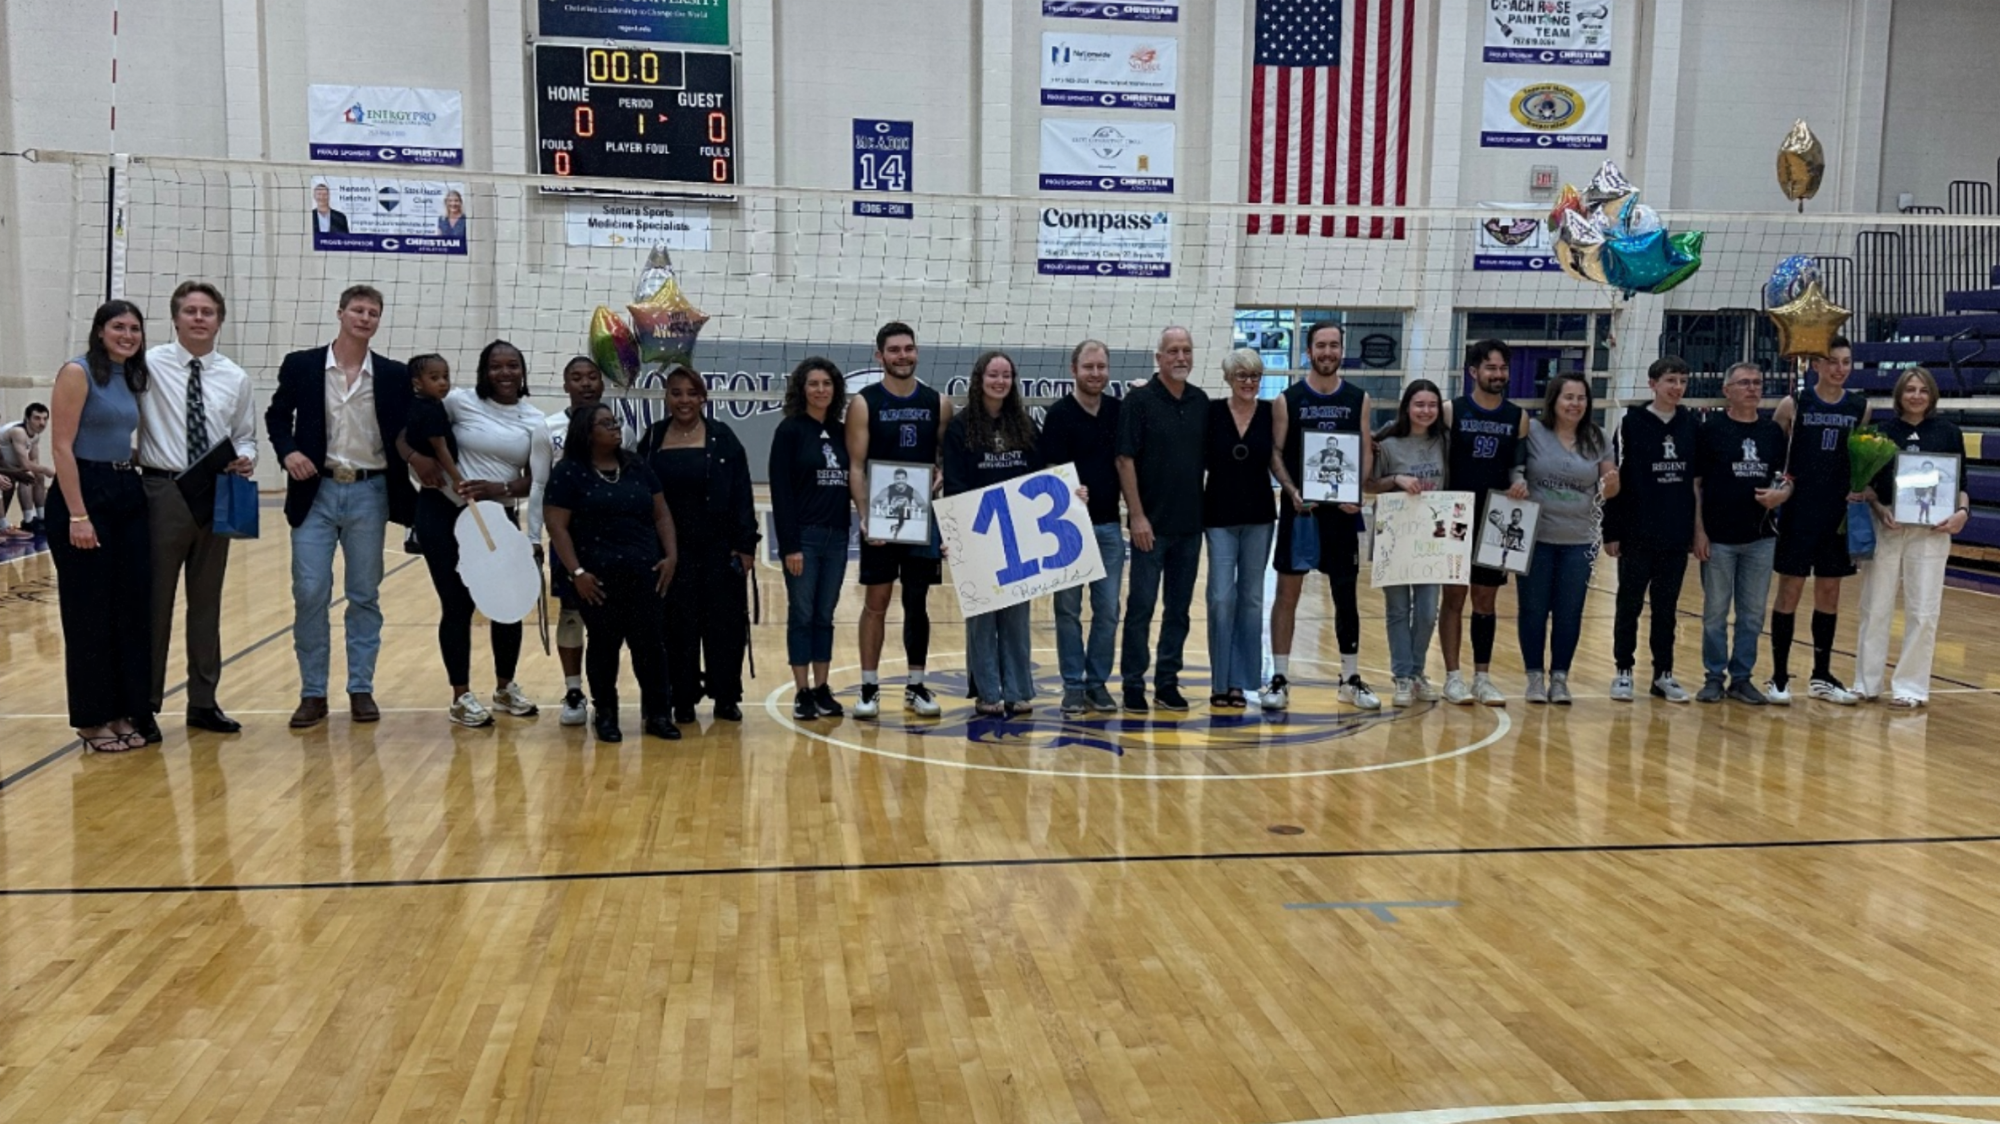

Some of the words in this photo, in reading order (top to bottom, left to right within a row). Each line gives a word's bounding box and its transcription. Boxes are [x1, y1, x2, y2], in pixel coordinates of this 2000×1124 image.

[1123, 6, 1173, 15] CHRISTIAN
[1536, 27, 1570, 37] TEAM
[1559, 51, 1605, 59] CHRISTIAN
[548, 86, 590, 102] HOME
[677, 92, 724, 108] GUEST
[1121, 94, 1170, 103] CHRISTIAN
[619, 97, 653, 110] PERIOD
[575, 106, 594, 137] 0
[708, 112, 726, 143] 0
[542, 139, 574, 150] FOULS
[1556, 135, 1602, 143] CHRISTIAN
[402, 148, 457, 158] CHRISTIAN
[605, 142, 643, 153] PLAYER
[645, 143, 670, 154] FOUL
[700, 147, 730, 157] FOULS
[555, 151, 571, 176] 0
[713, 158, 727, 181] 0
[860, 153, 906, 191] 14
[1120, 178, 1168, 187] CHRISTIAN
[602, 205, 641, 217] Sentara
[642, 206, 675, 220] Sports
[588, 217, 636, 230] Medicine
[637, 220, 691, 232] Specialists
[1043, 207, 1152, 234] Compass
[405, 238, 460, 248] CHRISTIAN
[1117, 262, 1165, 271] CHRISTIAN
[879, 408, 932, 422] REGENT
[1299, 405, 1352, 419] REGENT
[1460, 419, 1514, 436] REGENT
[1803, 413, 1858, 428] REGENT
[899, 424, 918, 447] 13
[1472, 436, 1499, 458] 99
[983, 451, 1023, 462] REGENT
[1652, 461, 1687, 472] REGENT
[1732, 461, 1769, 471] REGENT
[816, 470, 849, 479] REGENT
[874, 504, 923, 519] KETH
[972, 474, 1083, 587] 13
